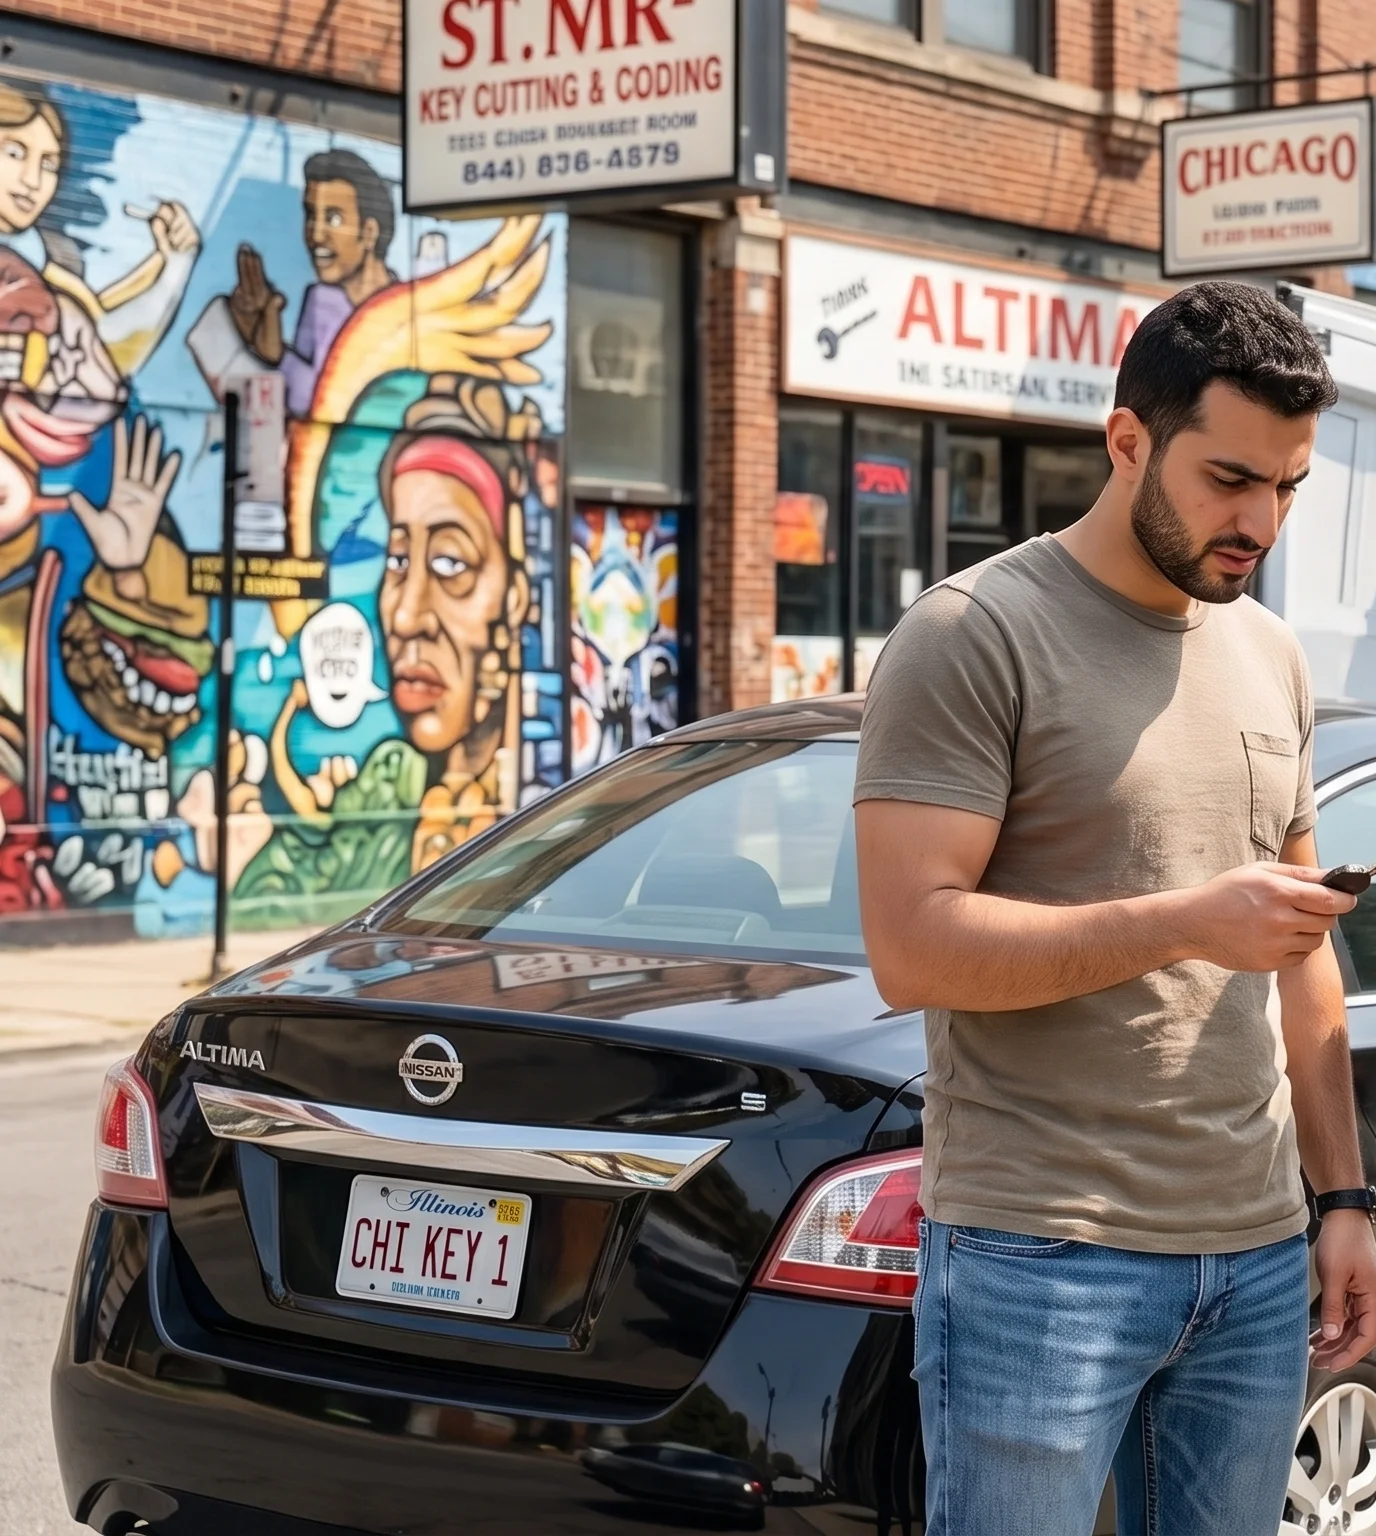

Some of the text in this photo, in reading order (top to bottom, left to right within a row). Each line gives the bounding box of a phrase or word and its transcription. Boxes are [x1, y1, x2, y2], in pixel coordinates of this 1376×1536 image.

[419, 56, 723, 124] KEY CUTTING & CODING
[1179, 133, 1357, 196] CHICAGO
[179, 1040, 266, 1071] ALTIMA
[404, 1061, 455, 1079] NISSAN
[741, 1092, 766, 1111] S
[387, 1189, 486, 1218] Illinois
[351, 1217, 509, 1287] CHI KEY 1
